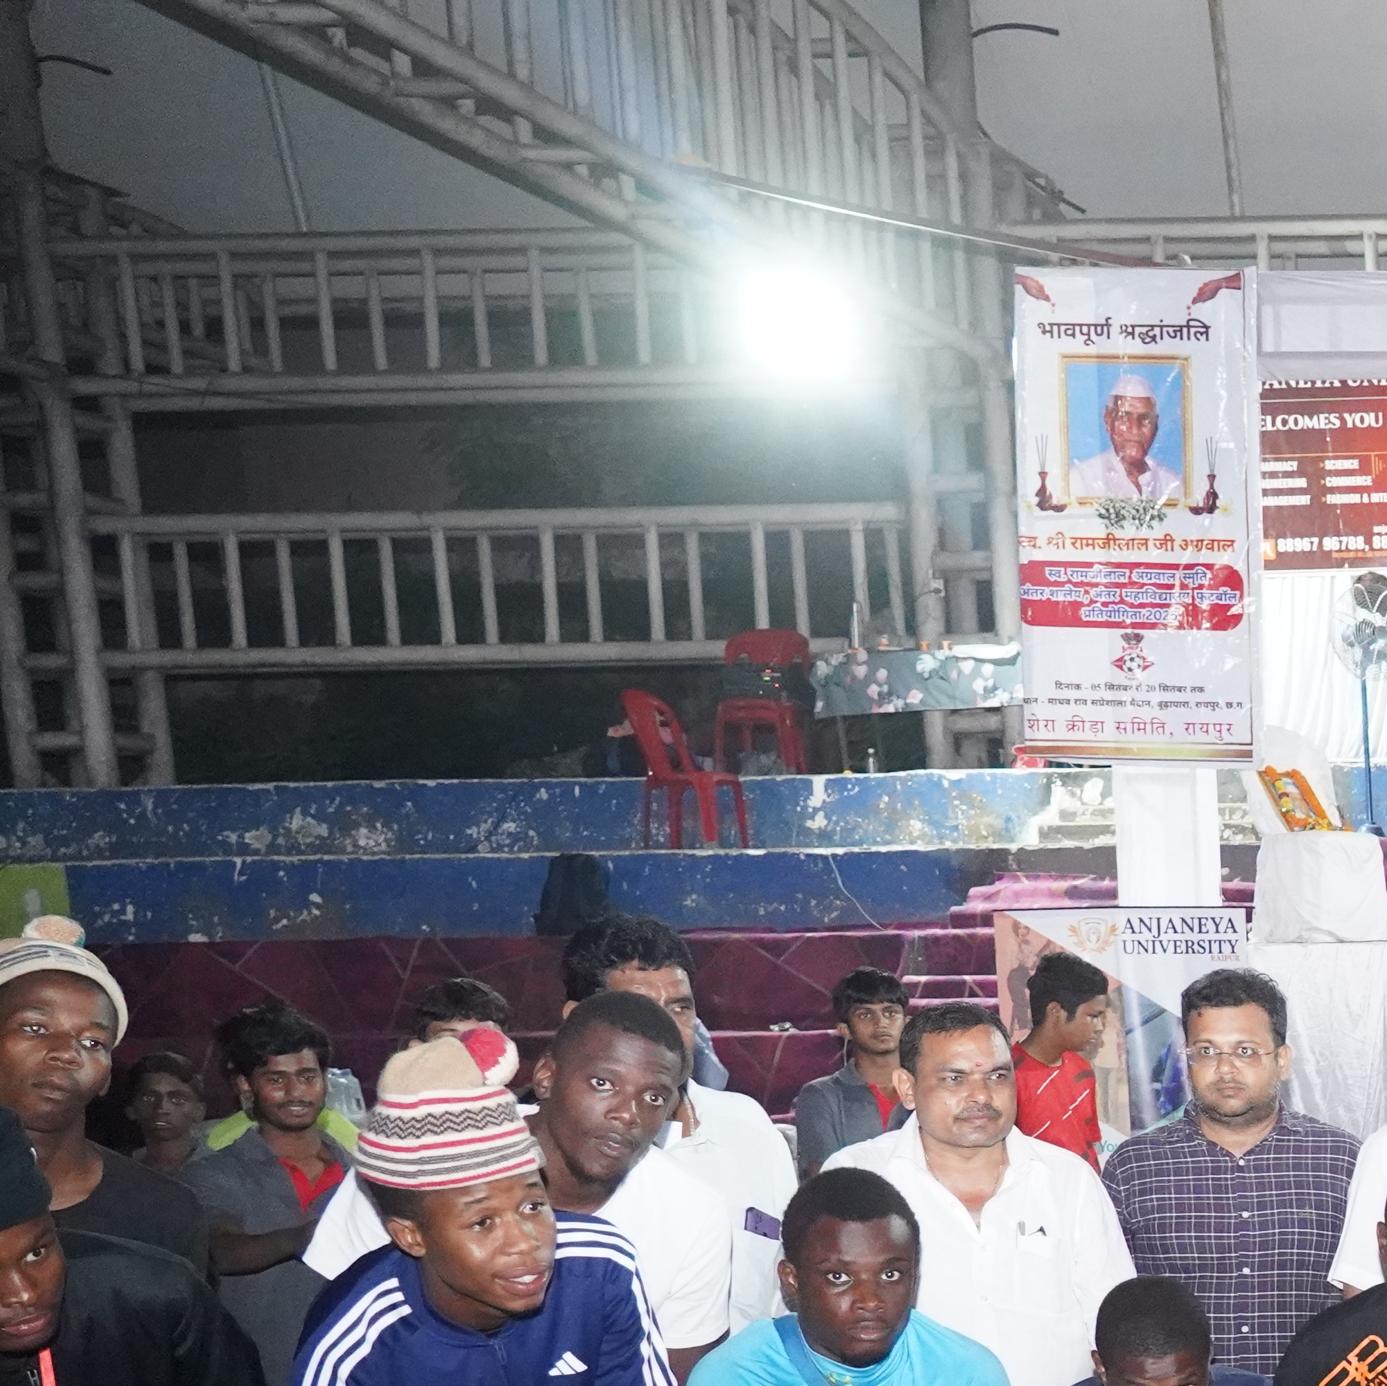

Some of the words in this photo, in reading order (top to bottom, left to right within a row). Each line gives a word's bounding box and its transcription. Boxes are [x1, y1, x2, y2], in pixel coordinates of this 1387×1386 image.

[1037, 317, 1112, 346] भावपूर्ण
[1118, 317, 1212, 345] श्रद्धांजलि
[1260, 413, 1341, 431] ELCOMES
[1343, 412, 1383, 429] YOU
[1070, 532, 1150, 551] रामजीलाल
[1153, 533, 1176, 552] जी
[1026, 713, 1057, 733] शेरा
[1183, 722, 1235, 742] रायपुर
[1121, 916, 1238, 937] ANJANEYA
[1123, 939, 1239, 956] UNIVERSITY
